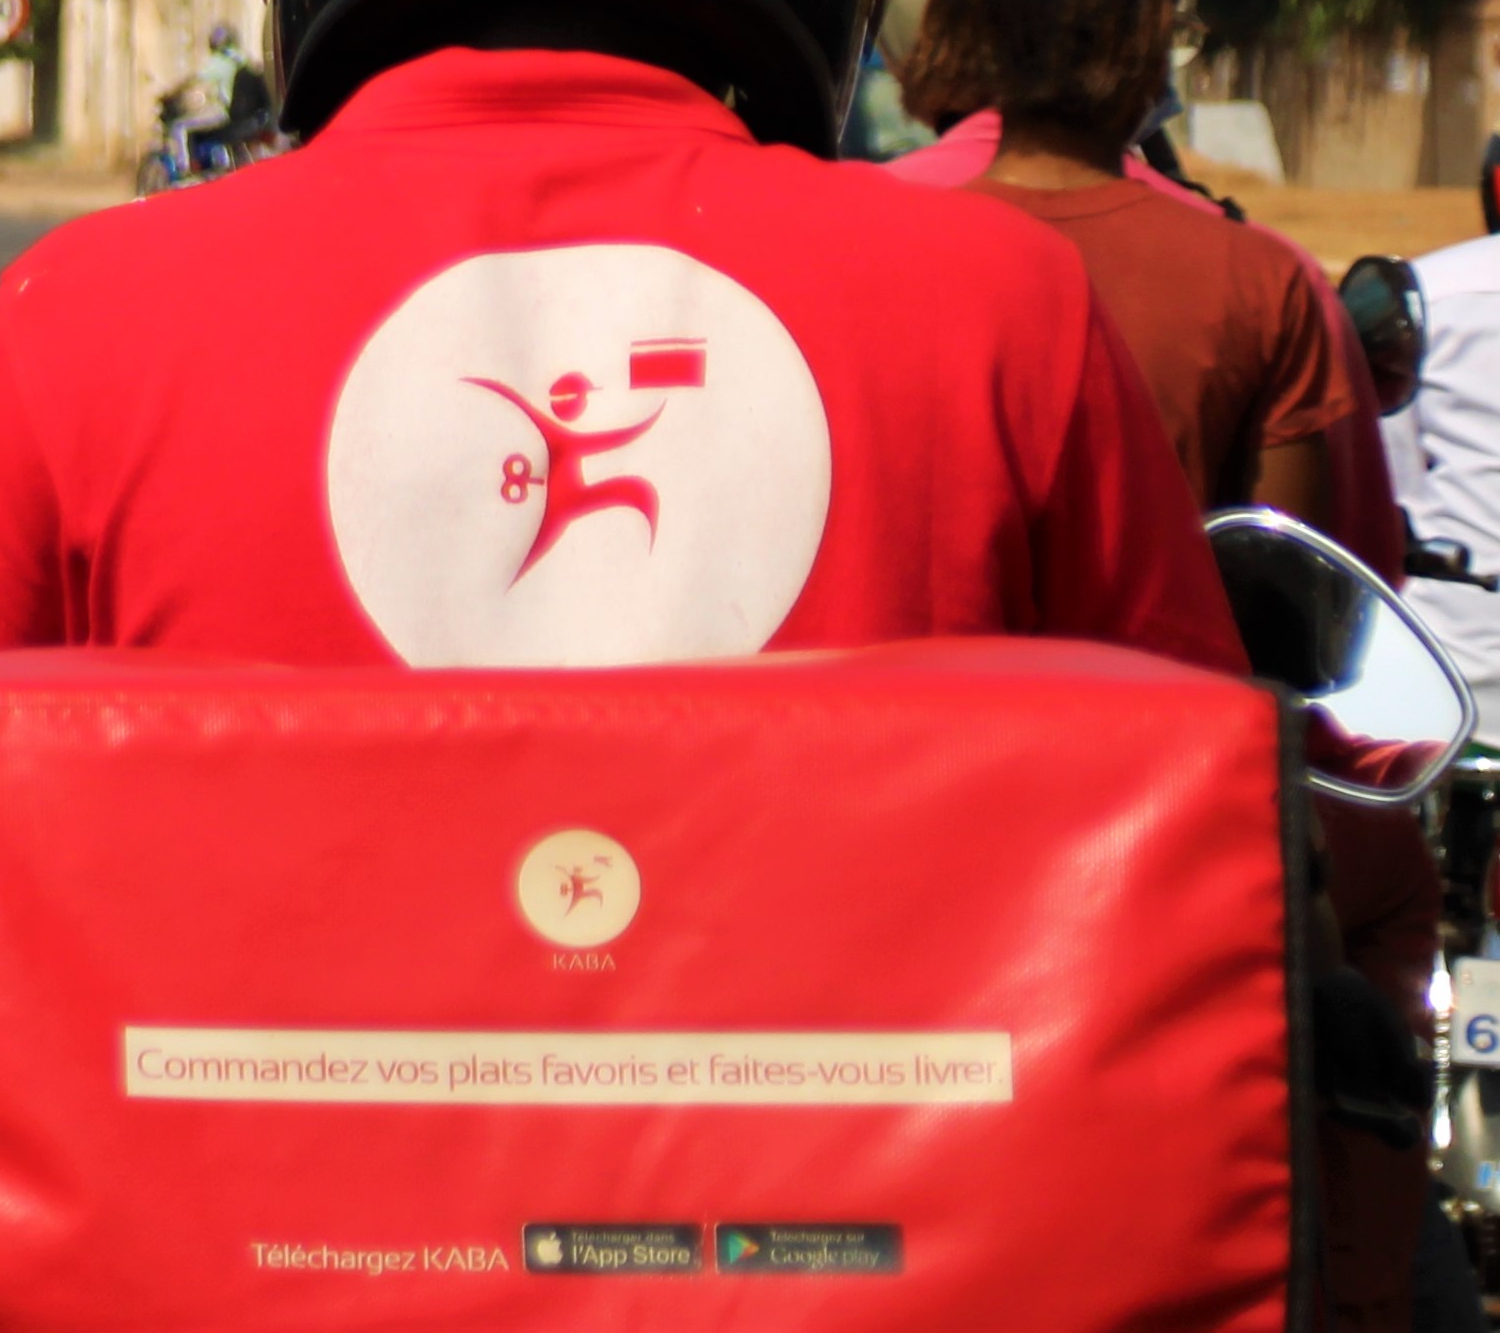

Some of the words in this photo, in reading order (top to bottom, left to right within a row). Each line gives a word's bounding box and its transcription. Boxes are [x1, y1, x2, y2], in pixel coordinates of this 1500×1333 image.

[552, 952, 617, 971] KABA
[136, 1047, 369, 1085] Commandez
[376, 1059, 439, 1085] vos
[448, 1052, 532, 1093] plats
[540, 1052, 659, 1086] favoris
[666, 1056, 701, 1086] et
[708, 1052, 905, 1086] faites-vous
[914, 1053, 1004, 1086] livrer.
[251, 1241, 416, 1276] Téléchargez
[422, 1246, 510, 1272] KABA
[572, 1244, 628, 1269] l'App
[632, 1244, 691, 1266] Store
[770, 1243, 838, 1270] Google
